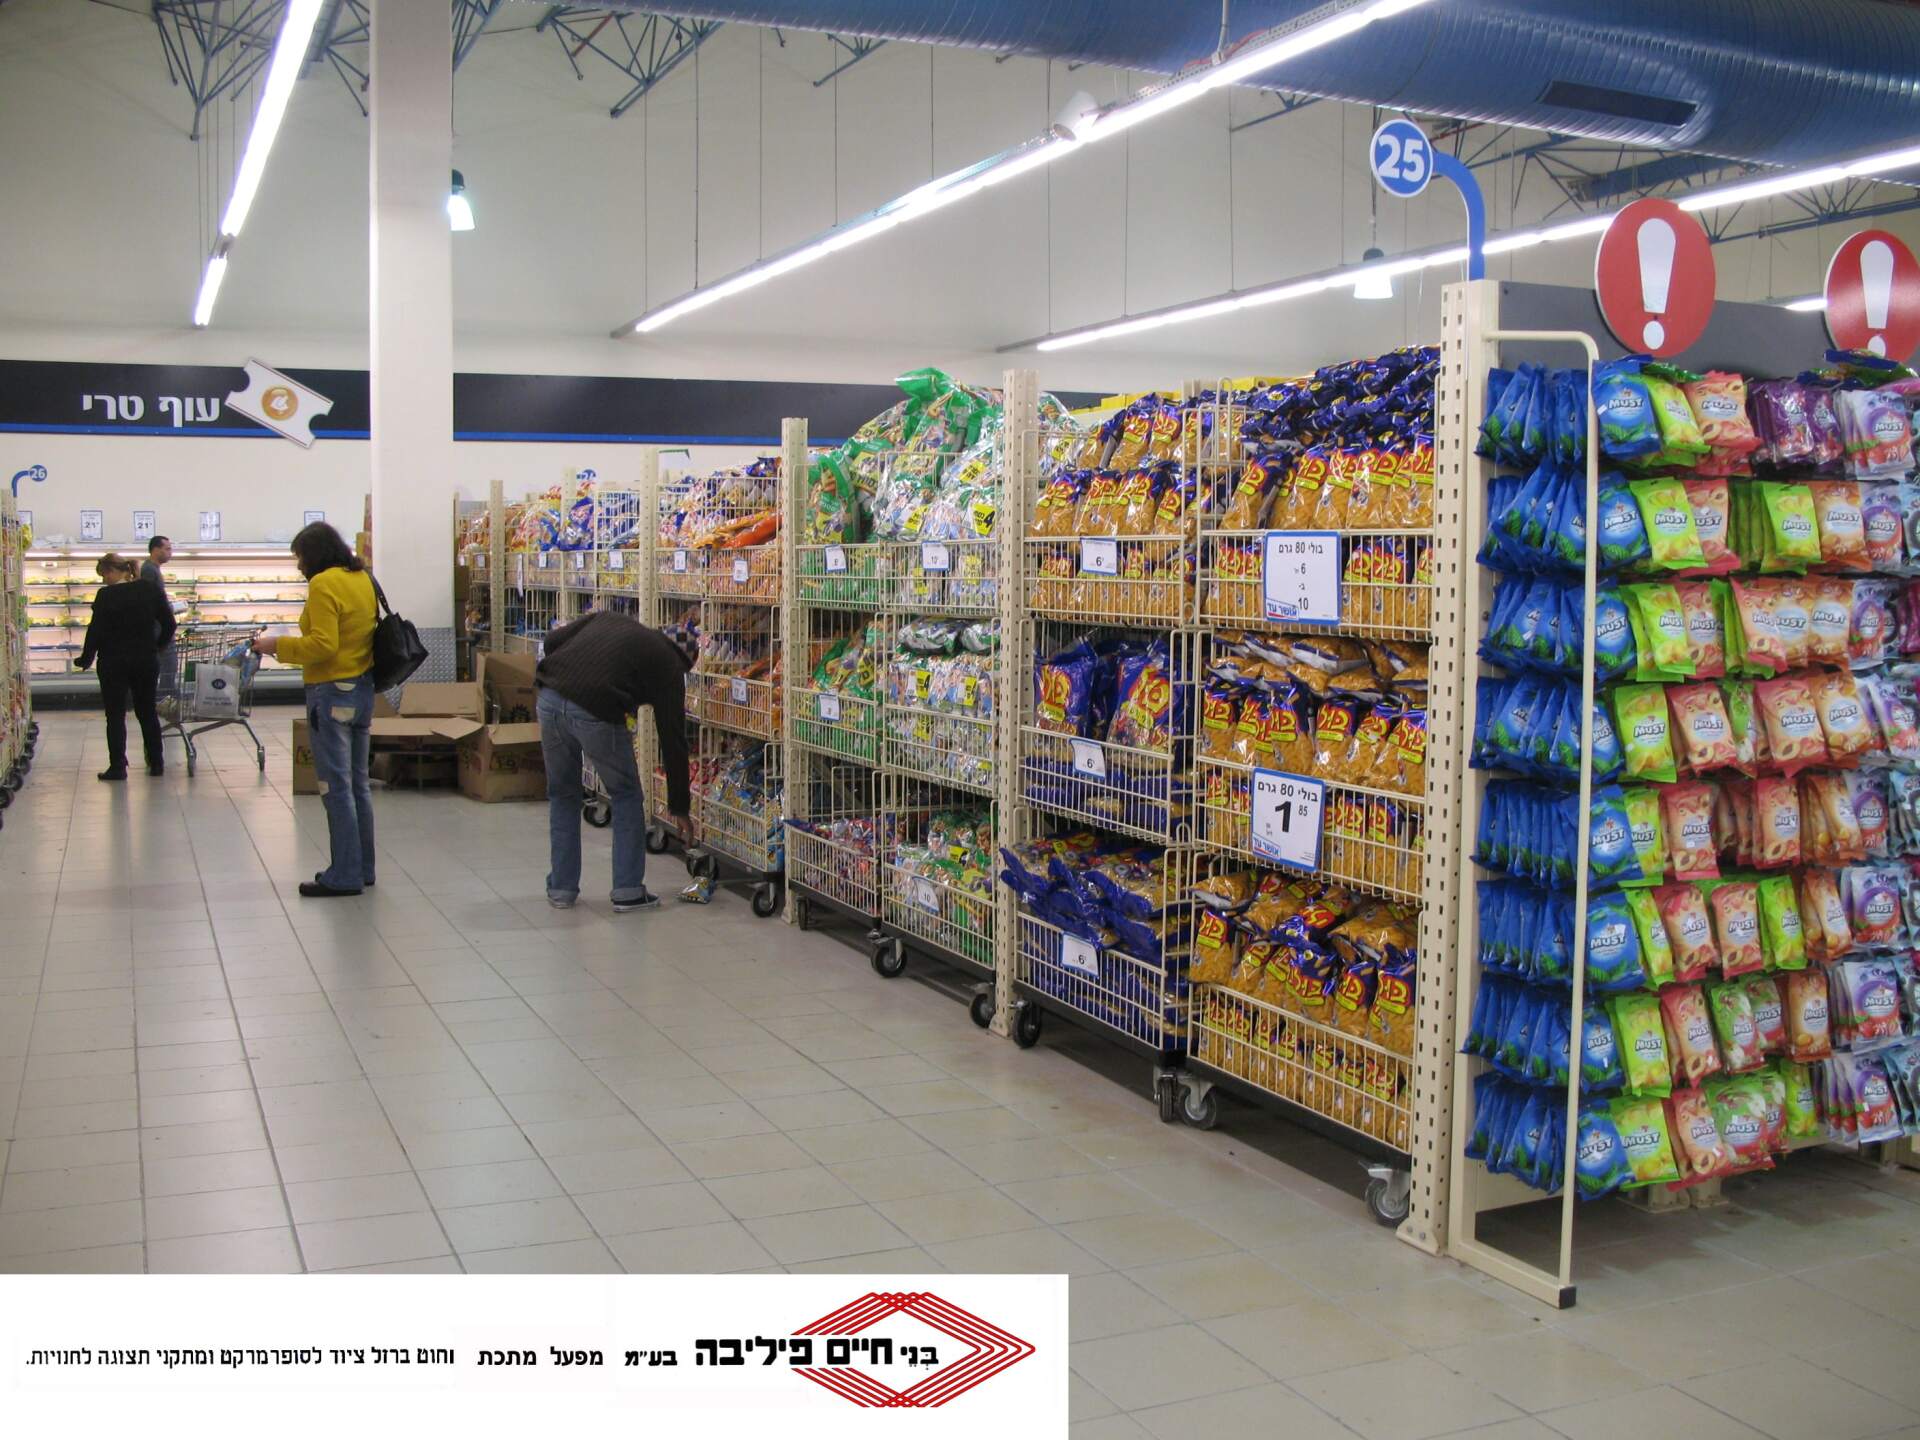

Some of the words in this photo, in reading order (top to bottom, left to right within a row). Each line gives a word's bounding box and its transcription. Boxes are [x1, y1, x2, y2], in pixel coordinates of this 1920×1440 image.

[1378, 134, 1425, 182] 25
[83, 394, 144, 422] טרי
[1608, 398, 1645, 410] MUST
[1702, 399, 1738, 411] MUST
[159, 394, 220, 427] עוף
[1875, 421, 1904, 432] MUST
[31, 468, 45, 480] 26
[1655, 512, 1688, 526] MUST
[1696, 515, 1722, 526] UST
[1827, 511, 1860, 522] MUST
[1783, 519, 1812, 531] MUST
[1868, 520, 1897, 531] MUST
[1279, 544, 1293, 554] גרם
[1295, 542, 1306, 554] 80
[1308, 543, 1323, 554] בולי
[1301, 563, 1306, 575] 6
[1298, 598, 1309, 610] 10
[1813, 611, 1846, 624] MUST
[1596, 617, 1627, 636] MUST
[1690, 619, 1716, 631] MUST
[1830, 705, 1858, 721] MUST
[1694, 719, 1724, 730] MUST
[1781, 714, 1816, 728] MUST
[1634, 723, 1665, 738] MUST
[1258, 781, 1276, 793] גרם
[1280, 784, 1294, 797] 80
[1298, 788, 1318, 802] בולי
[1275, 801, 1291, 833] 1
[1298, 805, 1308, 816] 85
[1859, 807, 1883, 818] MUST
[1775, 815, 1799, 826] MUST
[1592, 830, 1625, 847] MUST
[1631, 830, 1656, 842] MUST
[1866, 903, 1895, 914] MUST
[1728, 920, 1756, 933] MUST
[1590, 934, 1627, 950] MUST
[1864, 997, 1895, 1008] MUST
[1754, 1008, 1782, 1023] MUST
[1804, 1008, 1827, 1020] MUST
[1587, 1032, 1613, 1049] MUST
[1635, 1039, 1663, 1051] MUST
[1864, 1086, 1888, 1096] MUST
[1725, 1123, 1761, 1135] MUST
[1623, 1132, 1660, 1149] MUST
[1578, 1137, 1613, 1160] MUST
